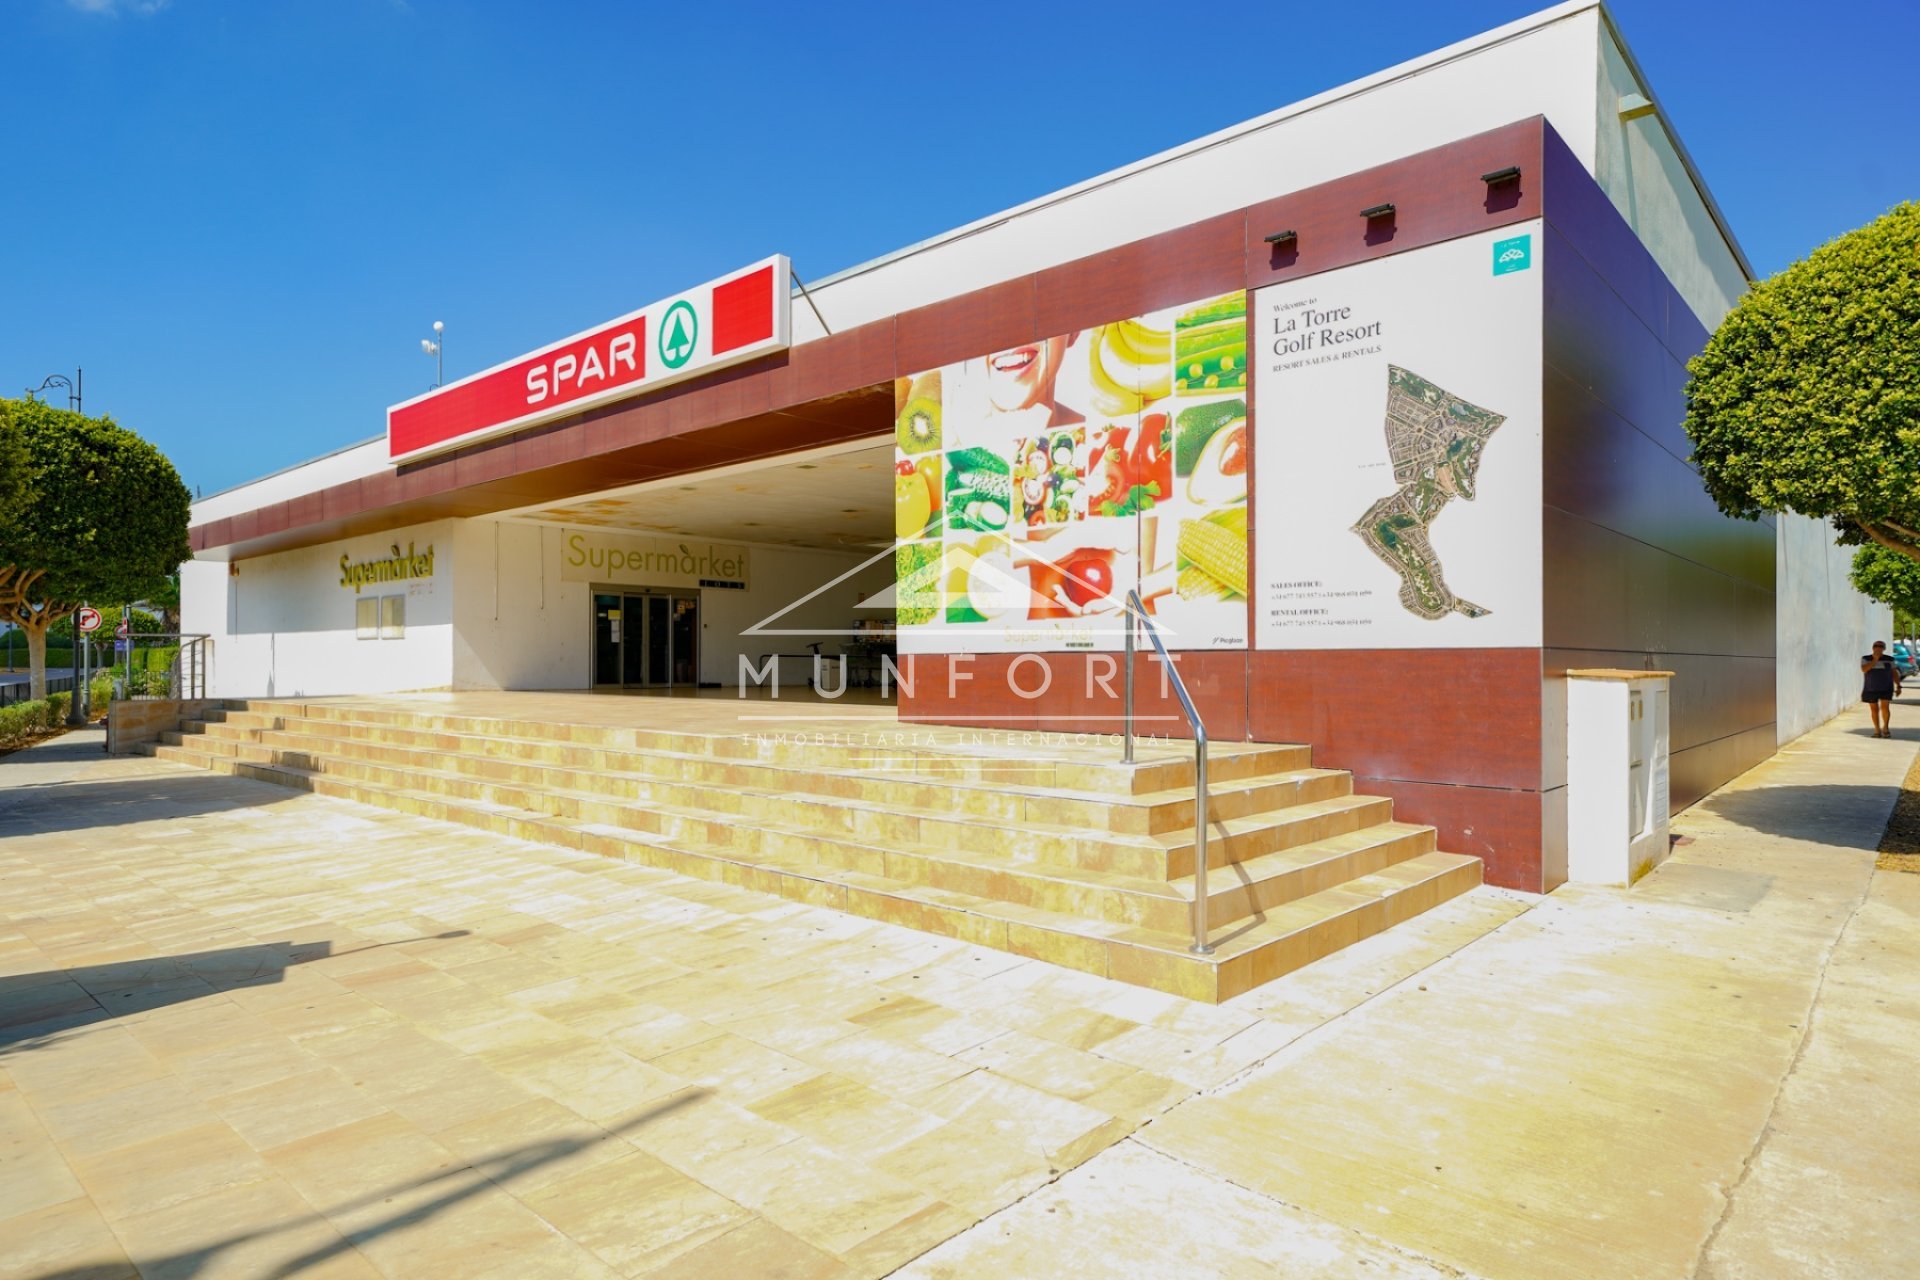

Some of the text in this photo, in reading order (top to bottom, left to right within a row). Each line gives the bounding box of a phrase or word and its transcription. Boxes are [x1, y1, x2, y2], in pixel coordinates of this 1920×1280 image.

[1273, 297, 1318, 312] Welcome to
[1273, 306, 1352, 335] La Torre
[1273, 320, 1382, 356] Golf Resort
[526, 332, 636, 405] SPAR
[1272, 343, 1383, 373] RESORT SALES & RENTALS
